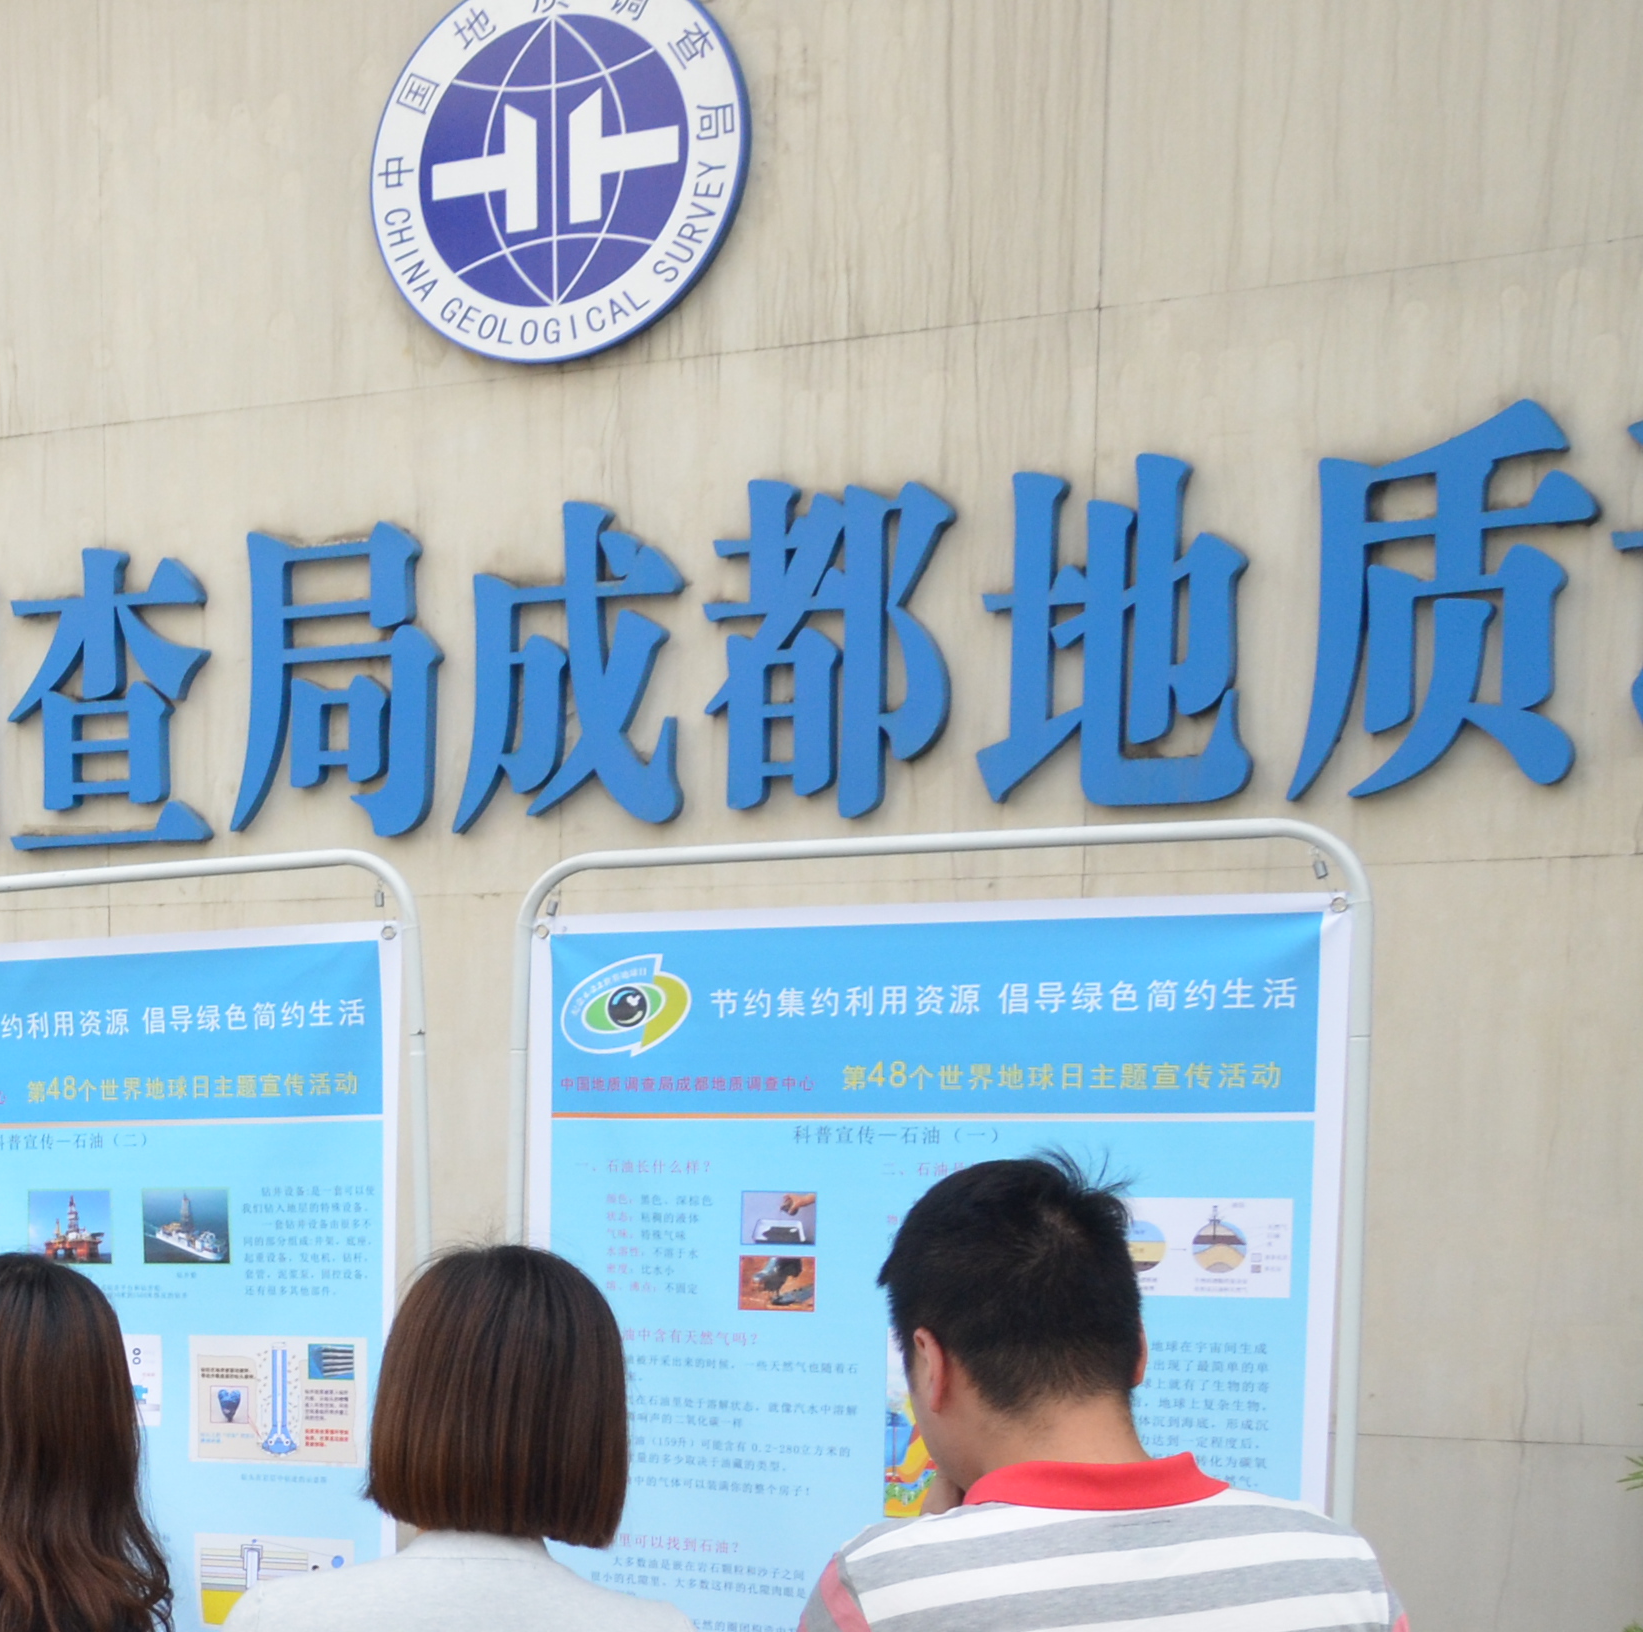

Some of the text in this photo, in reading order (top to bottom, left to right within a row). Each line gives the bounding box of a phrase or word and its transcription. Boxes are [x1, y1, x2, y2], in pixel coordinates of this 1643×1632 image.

[384, 160, 727, 346] CHINA GEOLOGICAL SURVEY
[709, 977, 1299, 1019] 节约集约利用资源 倡导绿色简约生活
[142, 998, 367, 1035] 倡导绿色简约生活
[27, 1071, 359, 1104] 第48个世界地球日主题宣传活动
[559, 1075, 815, 1092] 中国地质调查局成都地质调查中心
[841, 1060, 1283, 1092] 第48个世界地球日主题宣传活动
